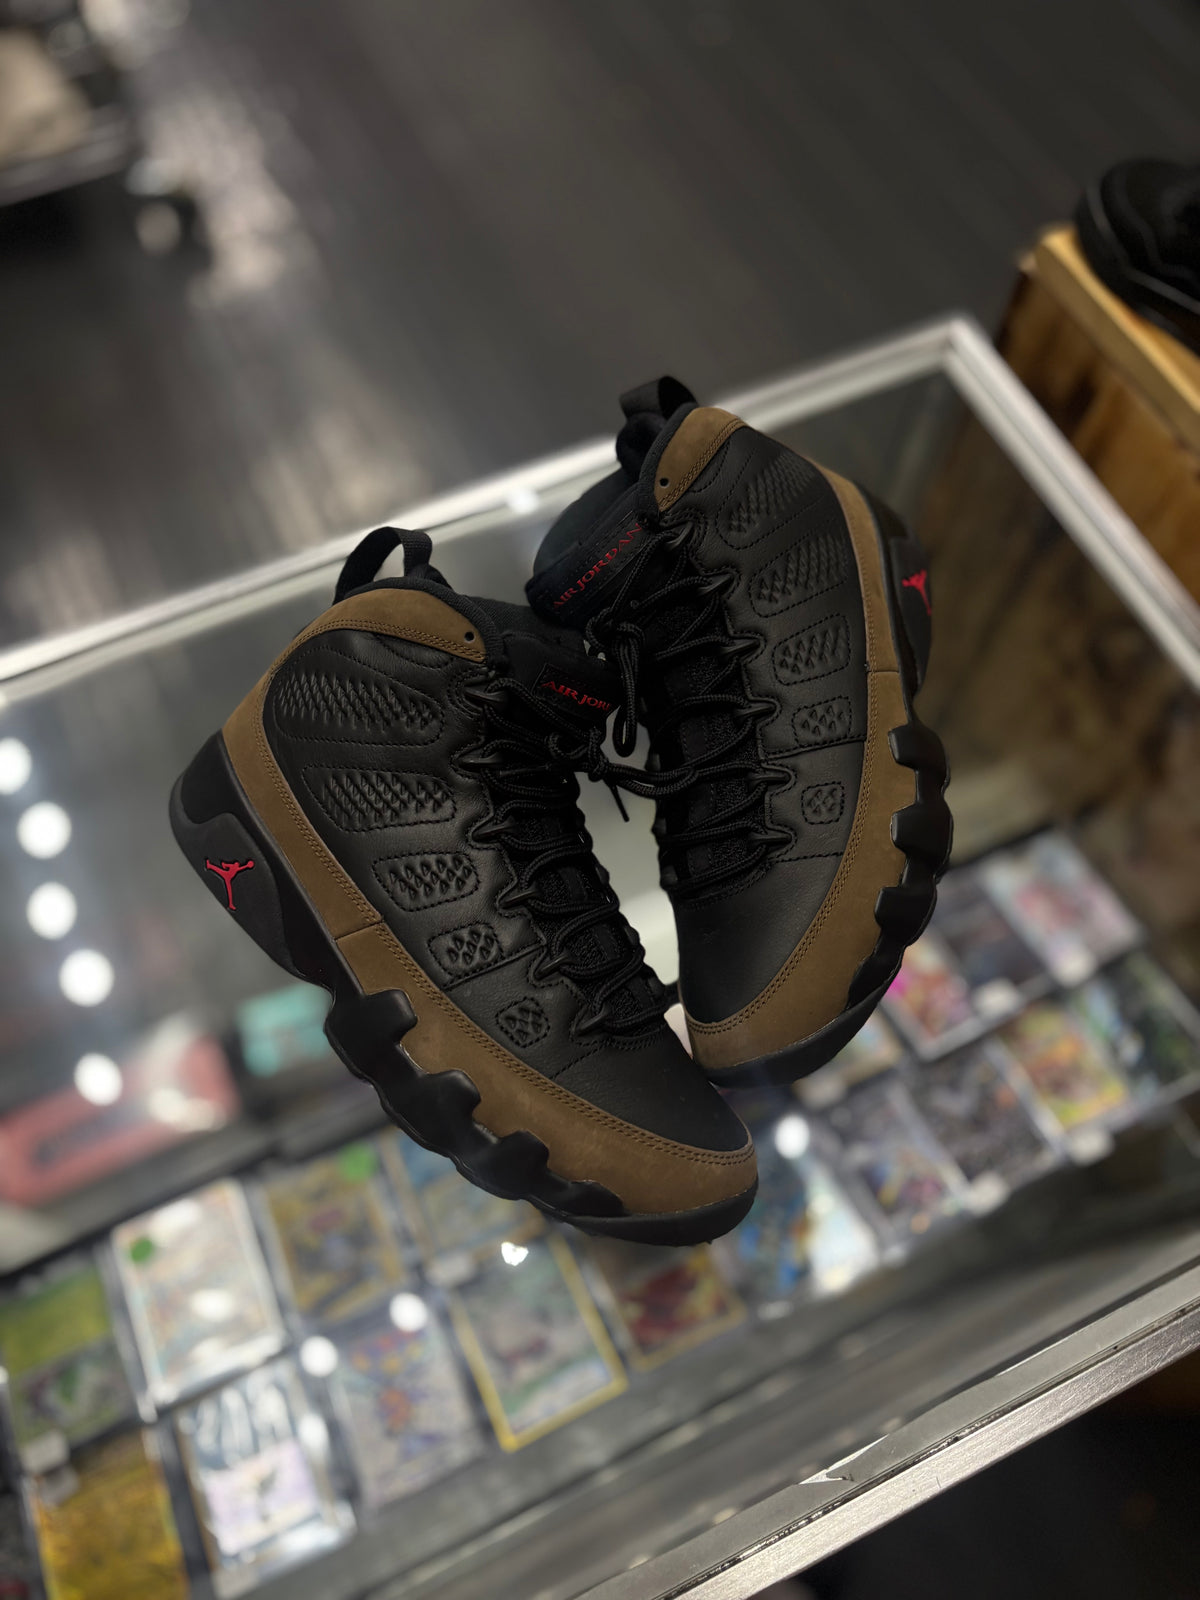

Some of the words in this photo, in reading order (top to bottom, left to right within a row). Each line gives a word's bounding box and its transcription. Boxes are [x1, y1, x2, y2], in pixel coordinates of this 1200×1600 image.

[553, 587, 577, 611] AIR
[576, 522, 643, 592] JORDAN
[541, 680, 578, 700] AIR
[577, 694, 611, 711] JOR
